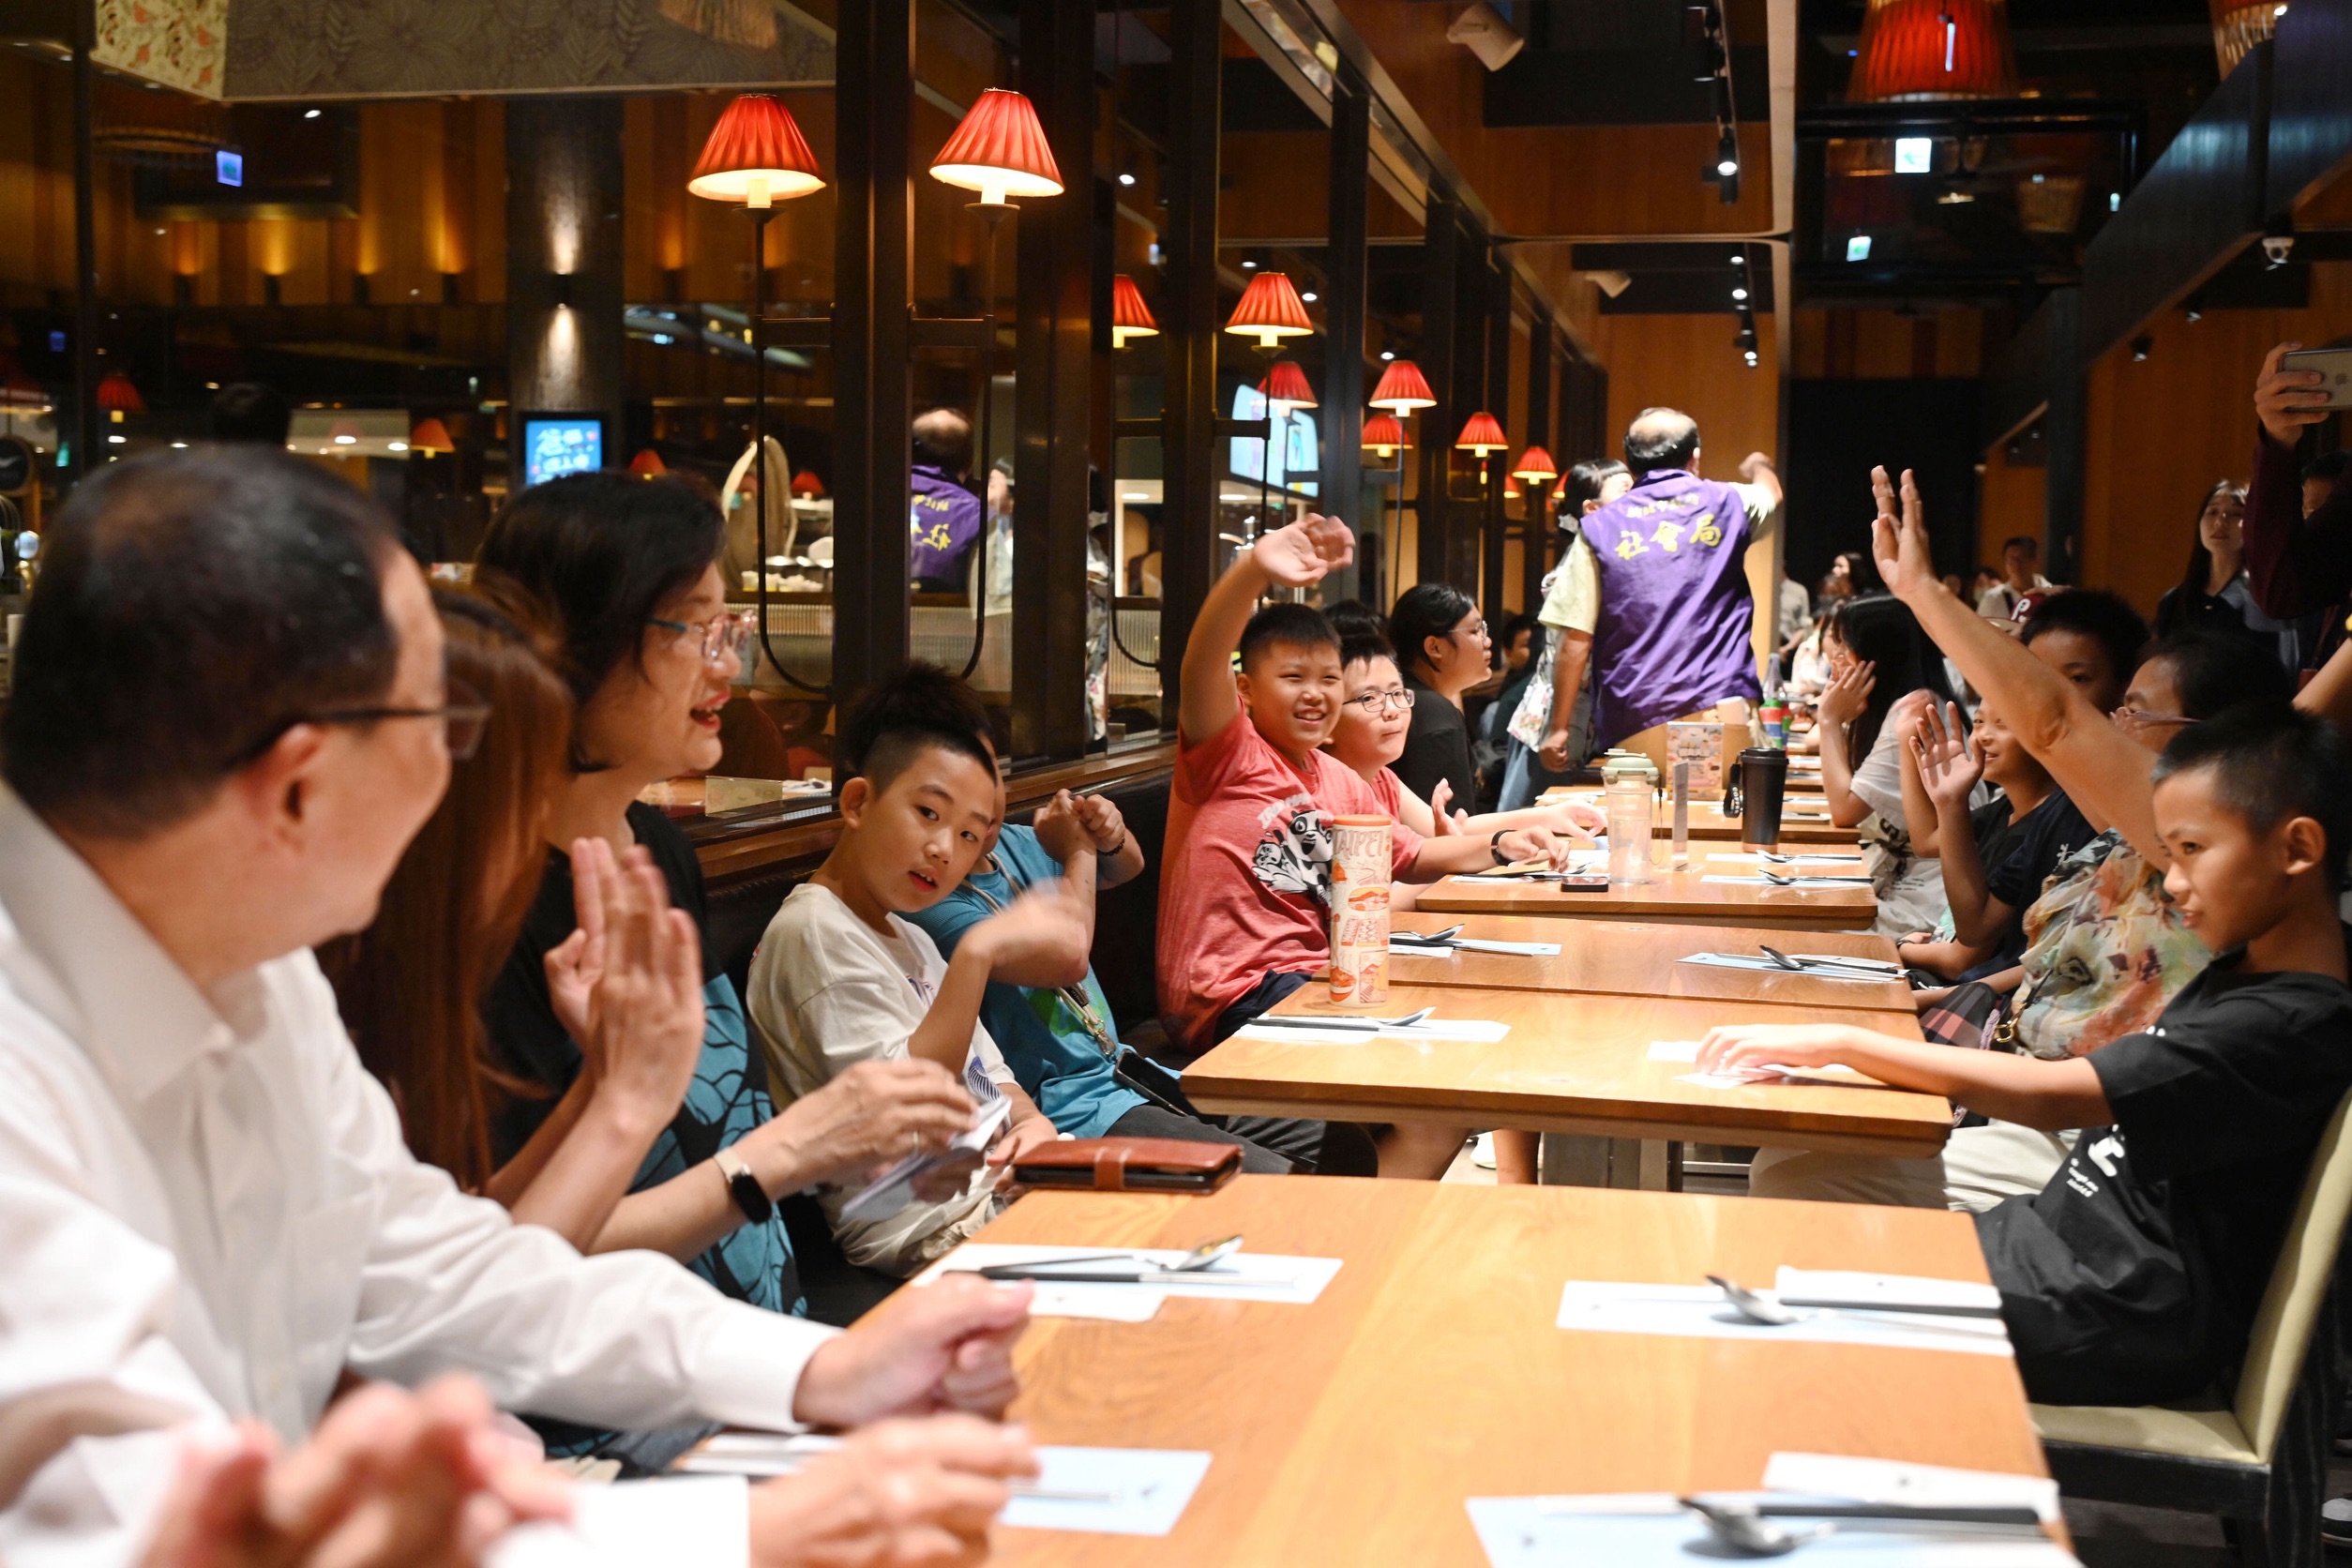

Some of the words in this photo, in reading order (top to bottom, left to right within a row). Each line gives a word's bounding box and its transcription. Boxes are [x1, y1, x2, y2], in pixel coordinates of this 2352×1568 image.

[1615, 514, 1722, 561] 社會局
[1333, 828, 1384, 860] TAIPEI
